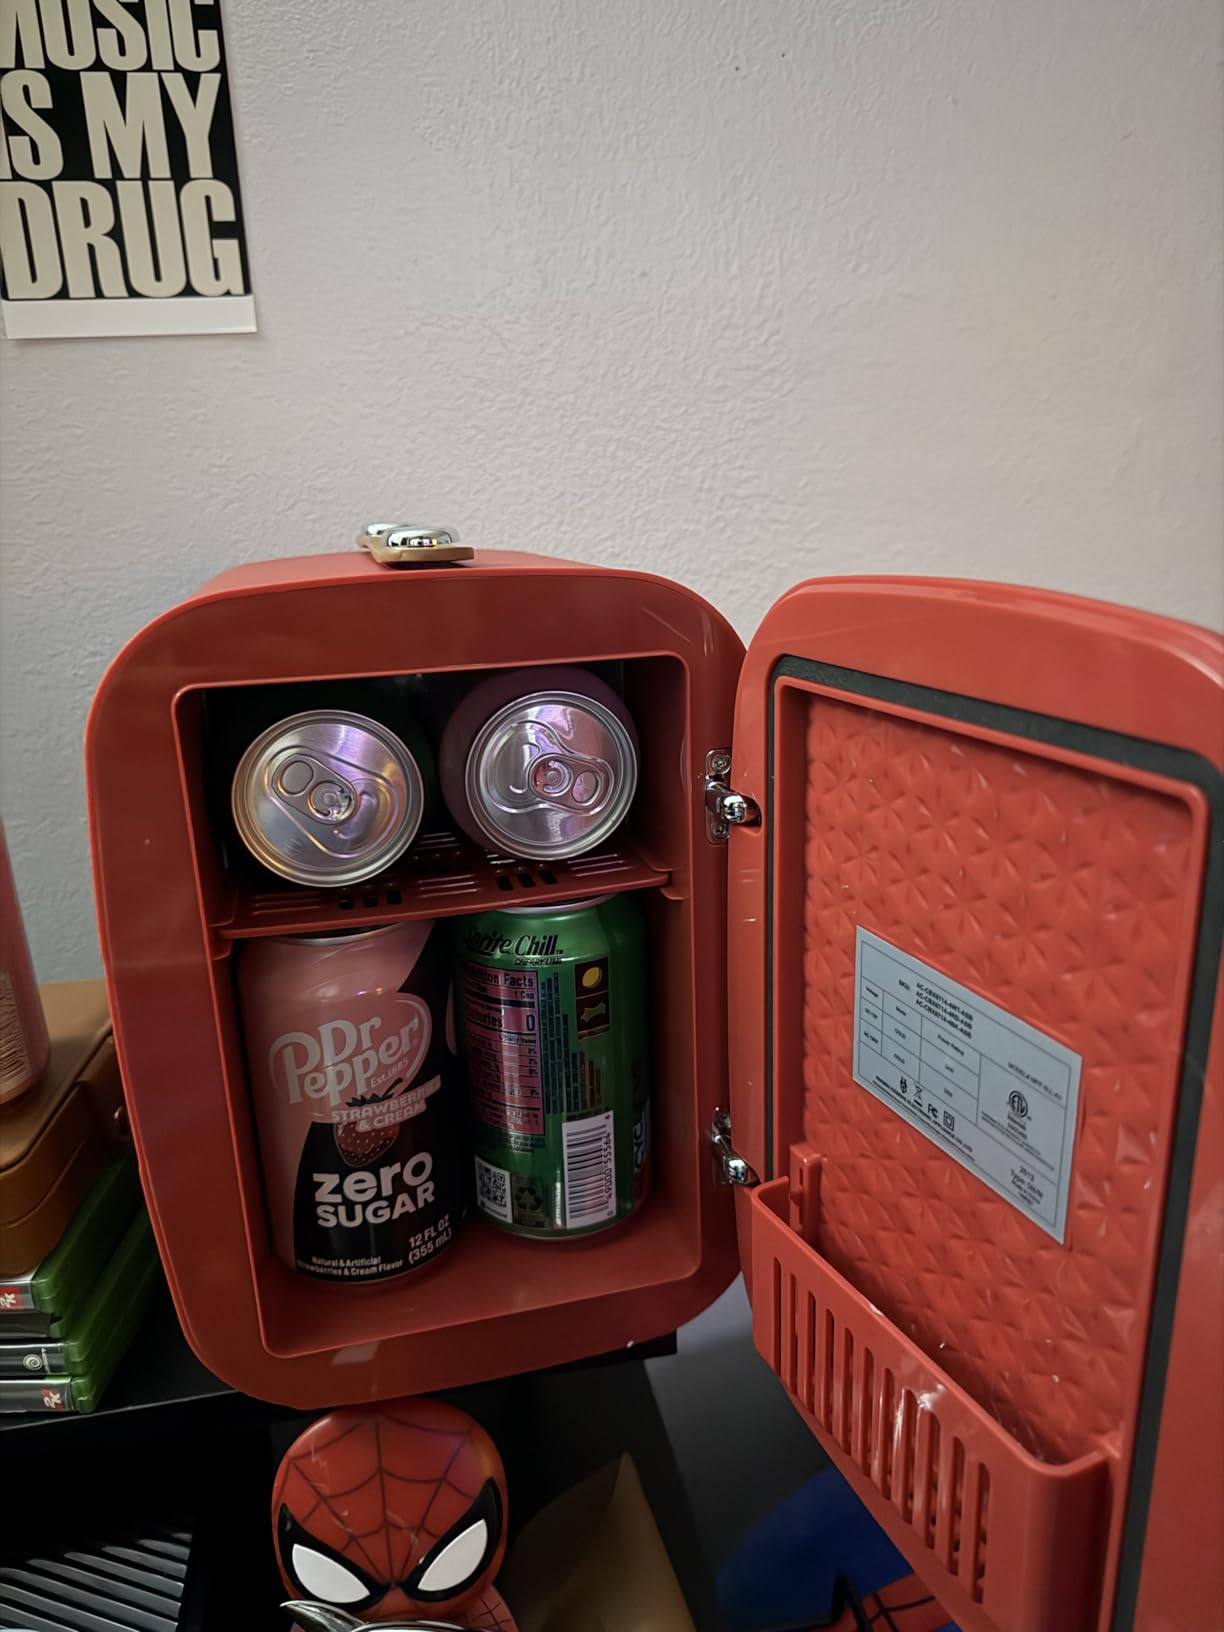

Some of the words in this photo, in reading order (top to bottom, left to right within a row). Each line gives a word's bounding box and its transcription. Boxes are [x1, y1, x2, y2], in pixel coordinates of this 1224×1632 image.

[0, 69, 64, 180] S
[79, 71, 221, 179] MY
[0, 178, 245, 299] DRUG
[515, 934, 559, 956] Chill
[504, 973, 534, 987] Facts
[317, 1016, 382, 1068] Dr
[526, 1015, 536, 1031] 0
[269, 1015, 420, 1105] Pepper
[312, 1151, 433, 1204] zero
[315, 1179, 435, 1228] SUGAR
[407, 1240, 435, 1265] (355
[434, 1226, 452, 1249] mL)
[408, 1232, 424, 1249] 12
[423, 1226, 438, 1241] FL
[437, 1213, 450, 1232] OZ
[43, 1391, 62, 1409] 2K
